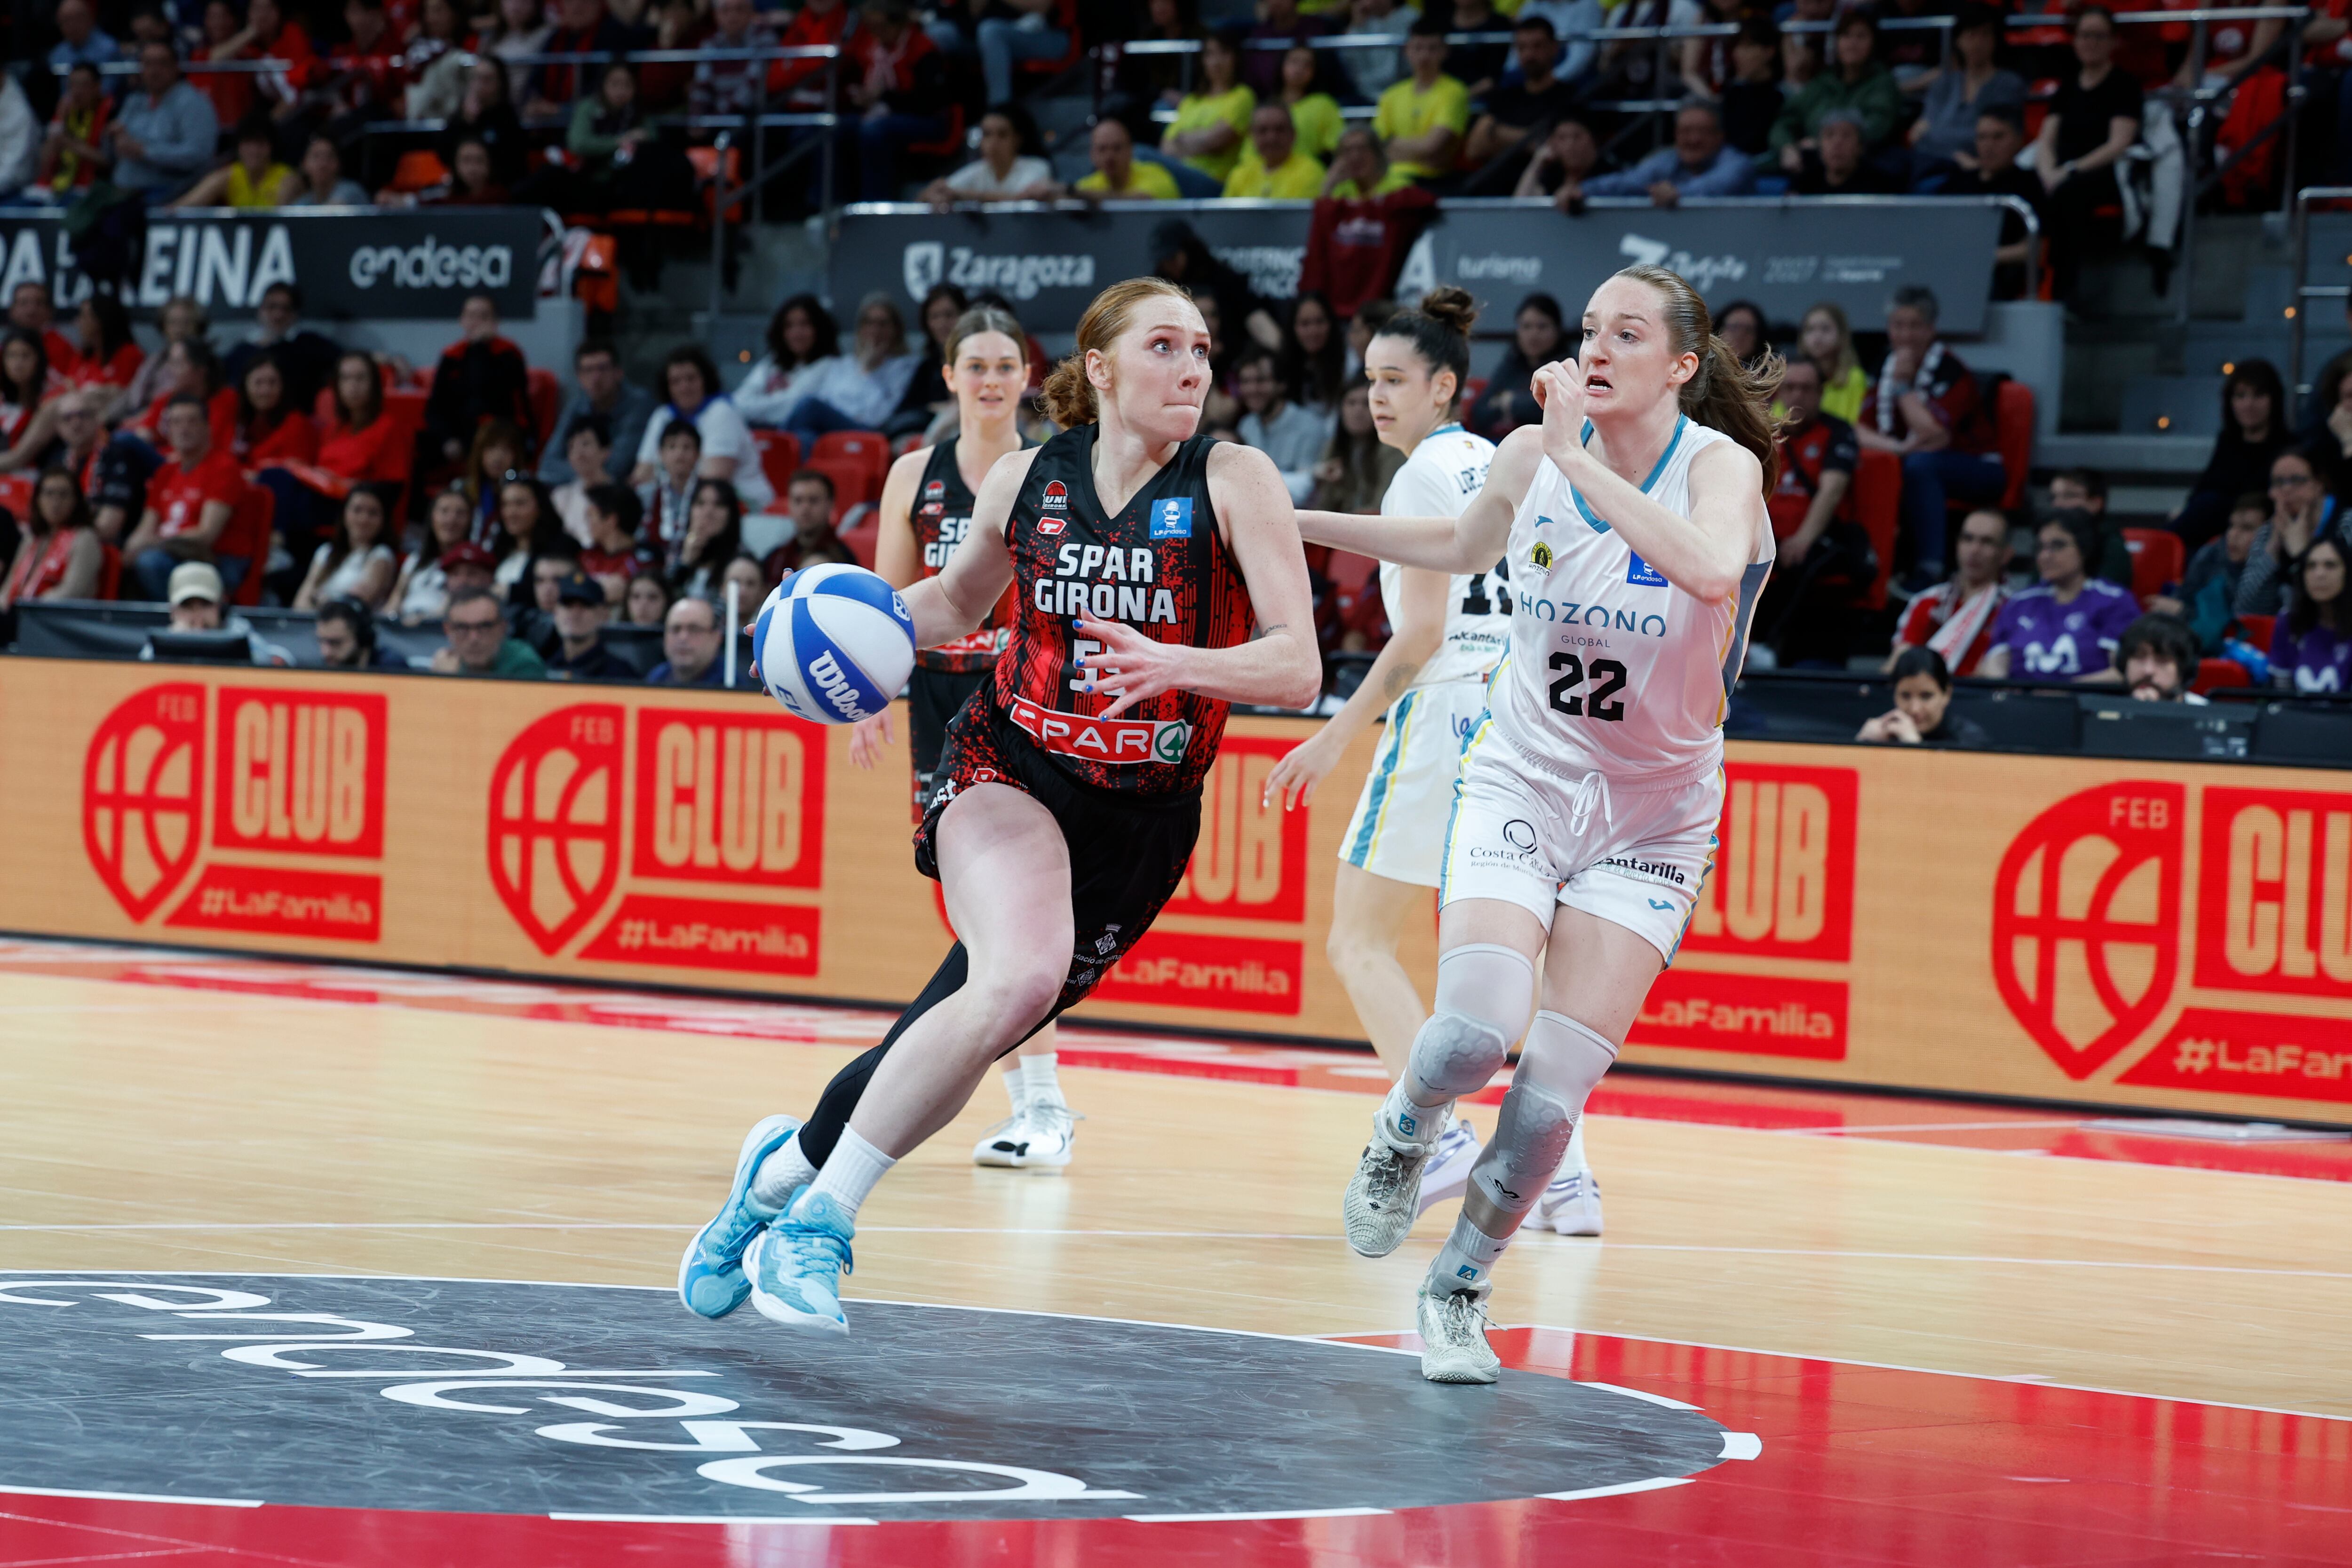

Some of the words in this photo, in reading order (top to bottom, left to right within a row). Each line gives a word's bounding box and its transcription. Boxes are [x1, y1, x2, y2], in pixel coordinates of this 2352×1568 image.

[120, 223, 295, 308] EINA
[350, 236, 511, 289] endesa
[948, 246, 1096, 300] Zaragoza
[1044, 495, 1066, 504] UNI
[1055, 543, 1153, 583] SPAR
[1528, 563, 1550, 577] HOZONO
[1035, 578, 1176, 624] GIRONA
[1520, 591, 1666, 638] HOZONO
[1561, 634, 1611, 648] GLOBAL
[1549, 651, 1627, 722] 22
[158, 694, 198, 722] FEB
[571, 715, 615, 744] FEB
[231, 699, 368, 843] CLUB
[653, 721, 805, 873] CLUB
[2110, 796, 2170, 830] FEB
[1470, 847, 1515, 862] Costa
[617, 919, 809, 958] #LaFamilia
